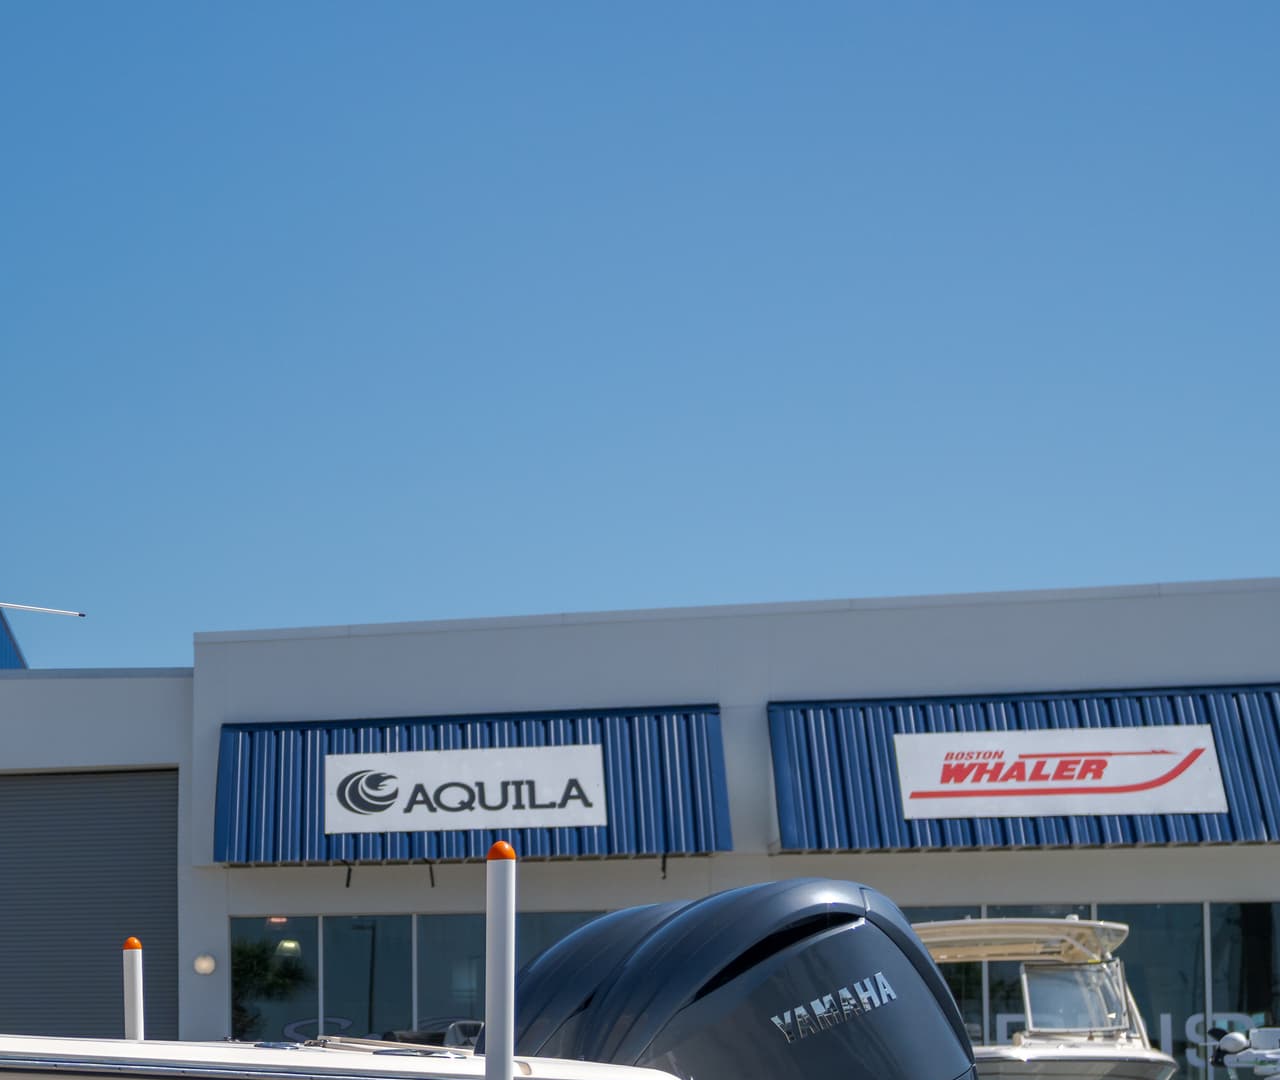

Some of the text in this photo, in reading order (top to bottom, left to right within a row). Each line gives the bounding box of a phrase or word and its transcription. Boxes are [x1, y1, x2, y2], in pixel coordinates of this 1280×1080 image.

[944, 750, 1004, 761] BOSTON
[940, 759, 1108, 784] WHALER
[403, 778, 593, 814] AQUILA
[770, 971, 897, 1044] YAMAHA
